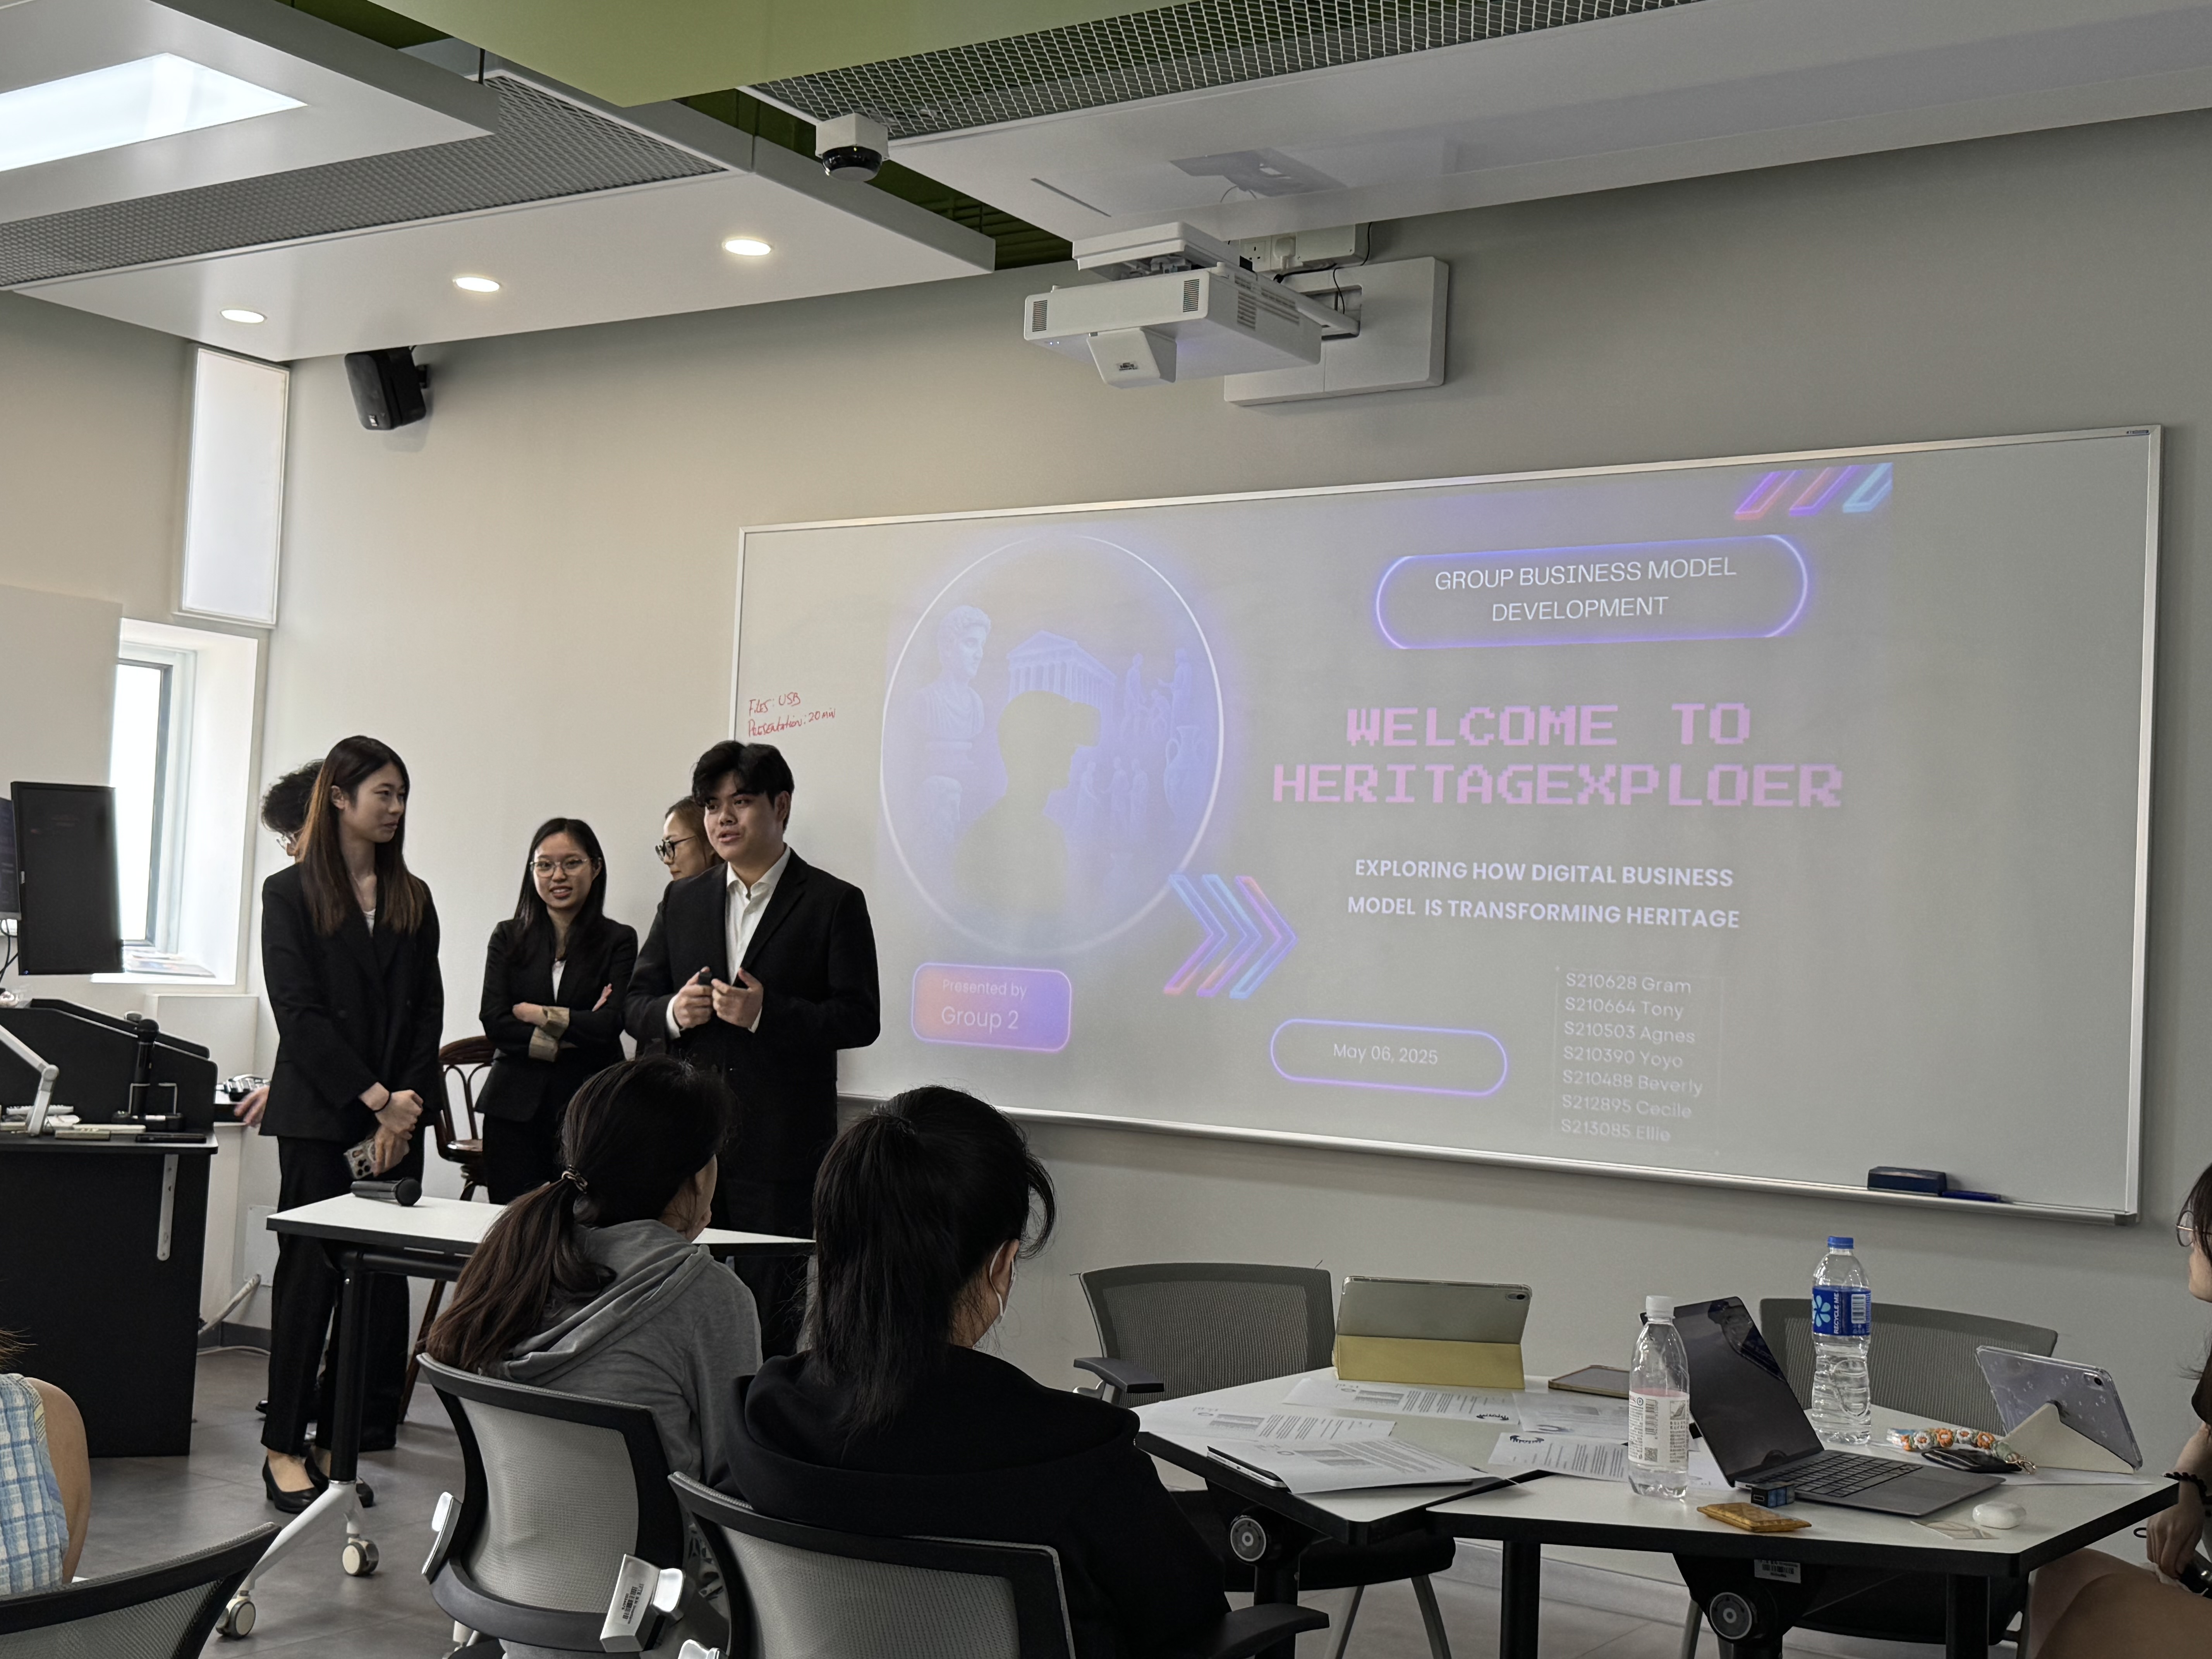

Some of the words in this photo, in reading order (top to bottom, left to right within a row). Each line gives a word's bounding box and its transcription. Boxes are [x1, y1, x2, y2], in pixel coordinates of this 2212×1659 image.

[1435, 568, 1513, 591] GROUP
[1519, 562, 1641, 586] BUSINESS
[1648, 557, 1736, 580] MODEL
[1492, 596, 1669, 621] DEVELOPMENT
[779, 692, 800, 706] USB
[809, 711, 821, 723] 20
[1347, 704, 1618, 747] WELCOME
[1671, 702, 1750, 745] TO
[1272, 763, 1843, 807] HERITAGEXPLOER
[1355, 859, 1468, 879] EXPLORING
[1473, 862, 1525, 881] HOW
[1532, 864, 1616, 883] DIGITAL
[1622, 866, 1733, 887] BUSINESS
[1348, 896, 1415, 914] MODEL
[1425, 899, 1443, 916] IS
[1448, 900, 1621, 923] TRANSFORMING
[1627, 906, 1740, 928] HERITAGE
[943, 979, 1007, 996] Presented
[1011, 982, 1027, 1001] by
[1566, 972, 1637, 990] S210628
[1642, 977, 1691, 994] Gram
[941, 1006, 1002, 1035] Group
[1008, 1010, 1019, 1029] 2
[1565, 996, 1636, 1014] S210664
[1640, 1001, 1683, 1021] Tony
[1564, 1021, 1635, 1039] S210503
[1640, 1026, 1695, 1045] Agnes
[1333, 1043, 1366, 1064] May
[1371, 1045, 1395, 1064] 06,
[1399, 1048, 1438, 1065] 2025
[1563, 1046, 1635, 1065] S210390
[1640, 1050, 1683, 1071] Yoyo
[1563, 1069, 1633, 1089] S210488
[1638, 1075, 1703, 1097] Beverly
[1562, 1094, 1632, 1113] S212895
[1636, 1100, 1692, 1119] Cecile
[1561, 1118, 1631, 1138] S213085
[1636, 1125, 1671, 1142] Ellie
